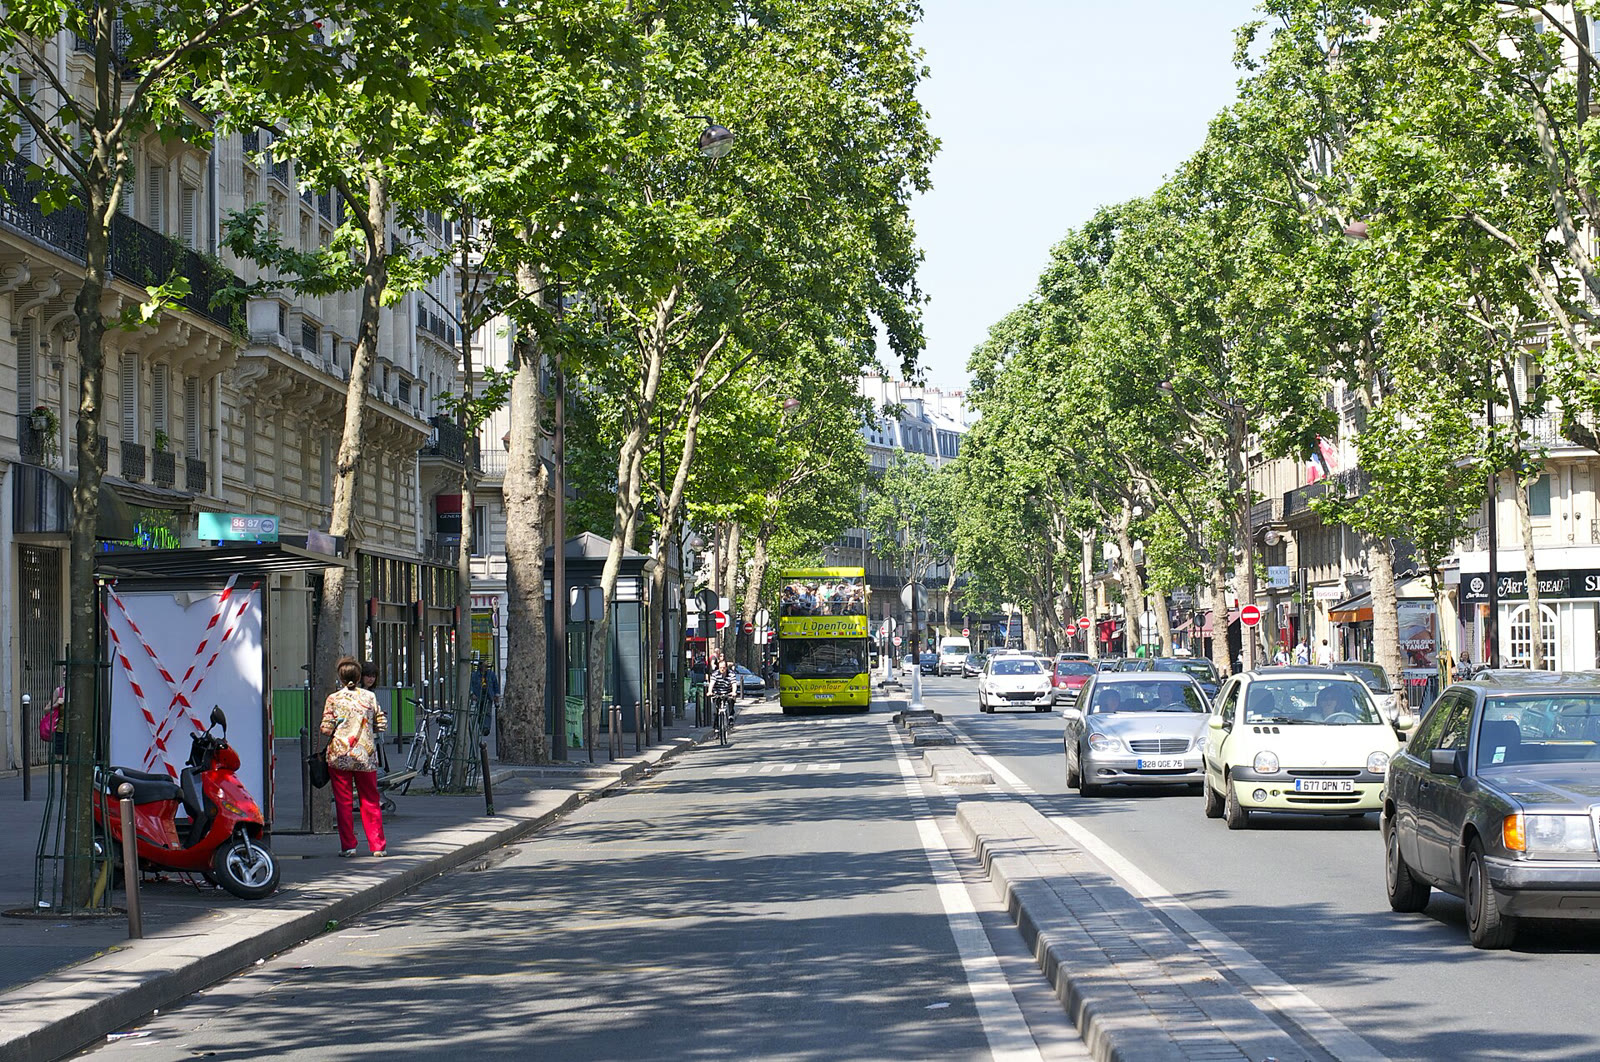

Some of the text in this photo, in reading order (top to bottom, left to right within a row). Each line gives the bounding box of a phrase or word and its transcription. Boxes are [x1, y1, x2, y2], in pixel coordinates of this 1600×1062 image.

[233, 519, 245, 527] 86
[247, 519, 258, 528] 87
[1173, 760, 1183, 768] 75
[1303, 781, 1352, 791] 677 QPN 75
